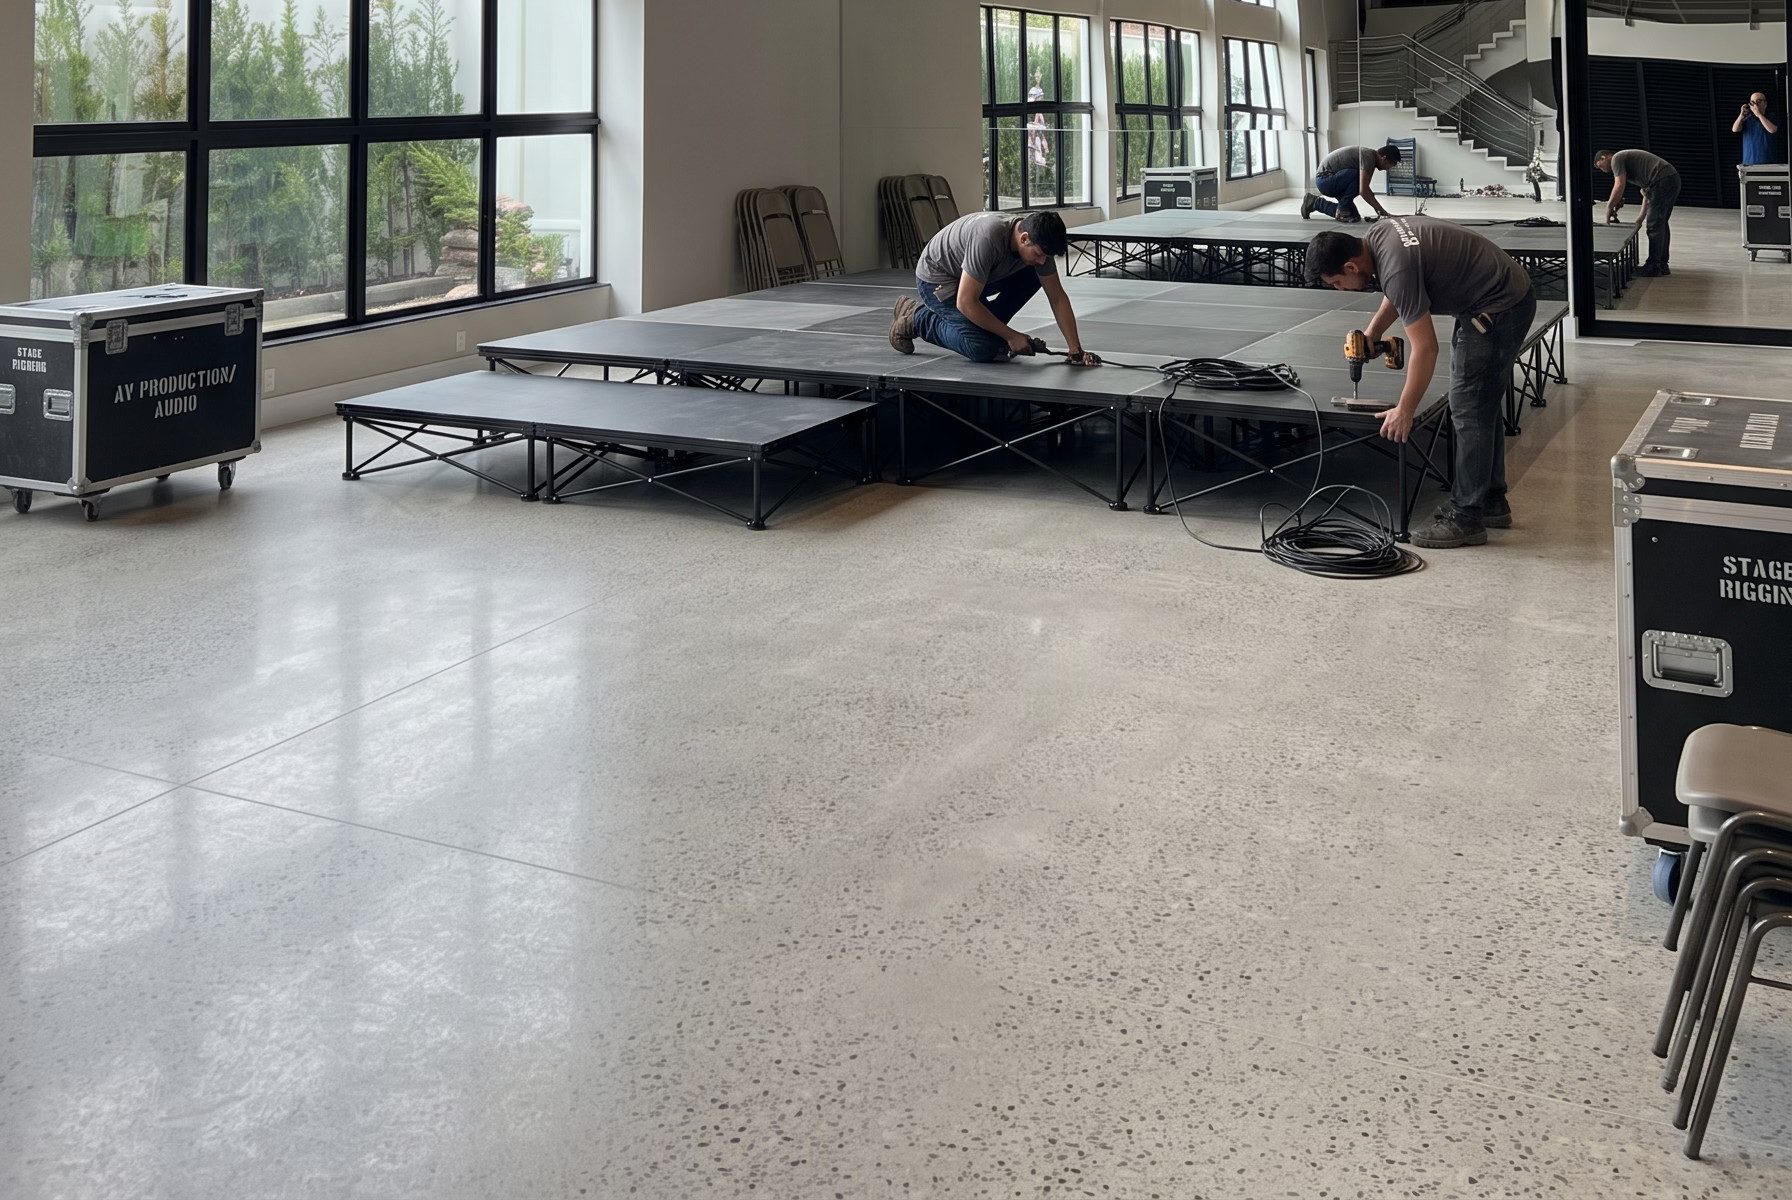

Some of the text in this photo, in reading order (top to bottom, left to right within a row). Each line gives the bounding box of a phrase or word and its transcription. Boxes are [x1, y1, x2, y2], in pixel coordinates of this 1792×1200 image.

[139, 363, 237, 399] PRODUCTION/
[154, 394, 198, 419] AUDIO
[1723, 555, 1792, 581] STAGE
